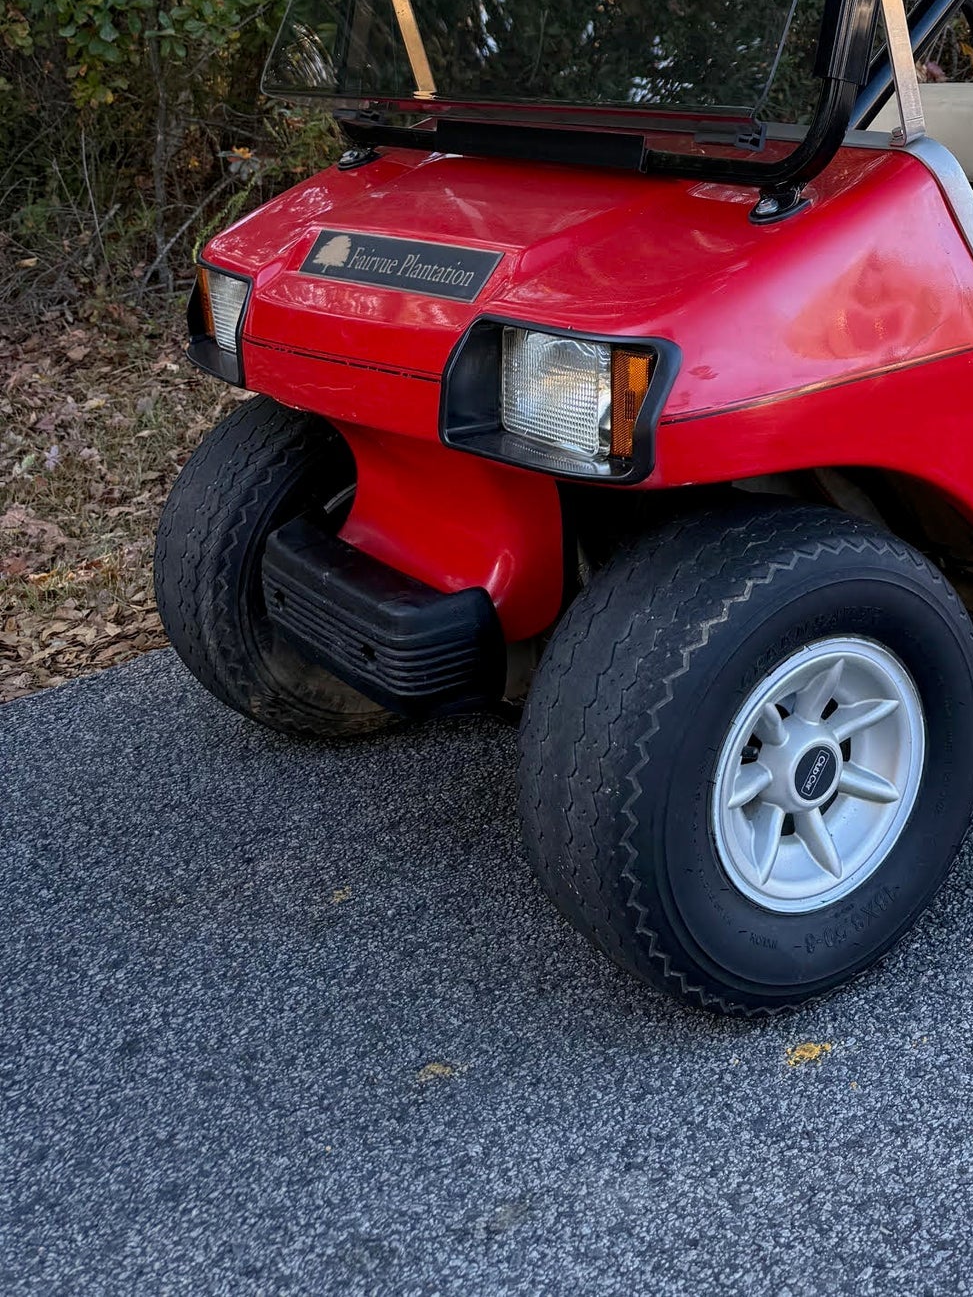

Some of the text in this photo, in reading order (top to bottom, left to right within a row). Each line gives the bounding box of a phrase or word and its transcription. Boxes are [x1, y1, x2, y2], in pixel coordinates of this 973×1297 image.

[347, 247, 474, 287] Fairvue Plantation
[805, 755, 826, 791] Club Car
